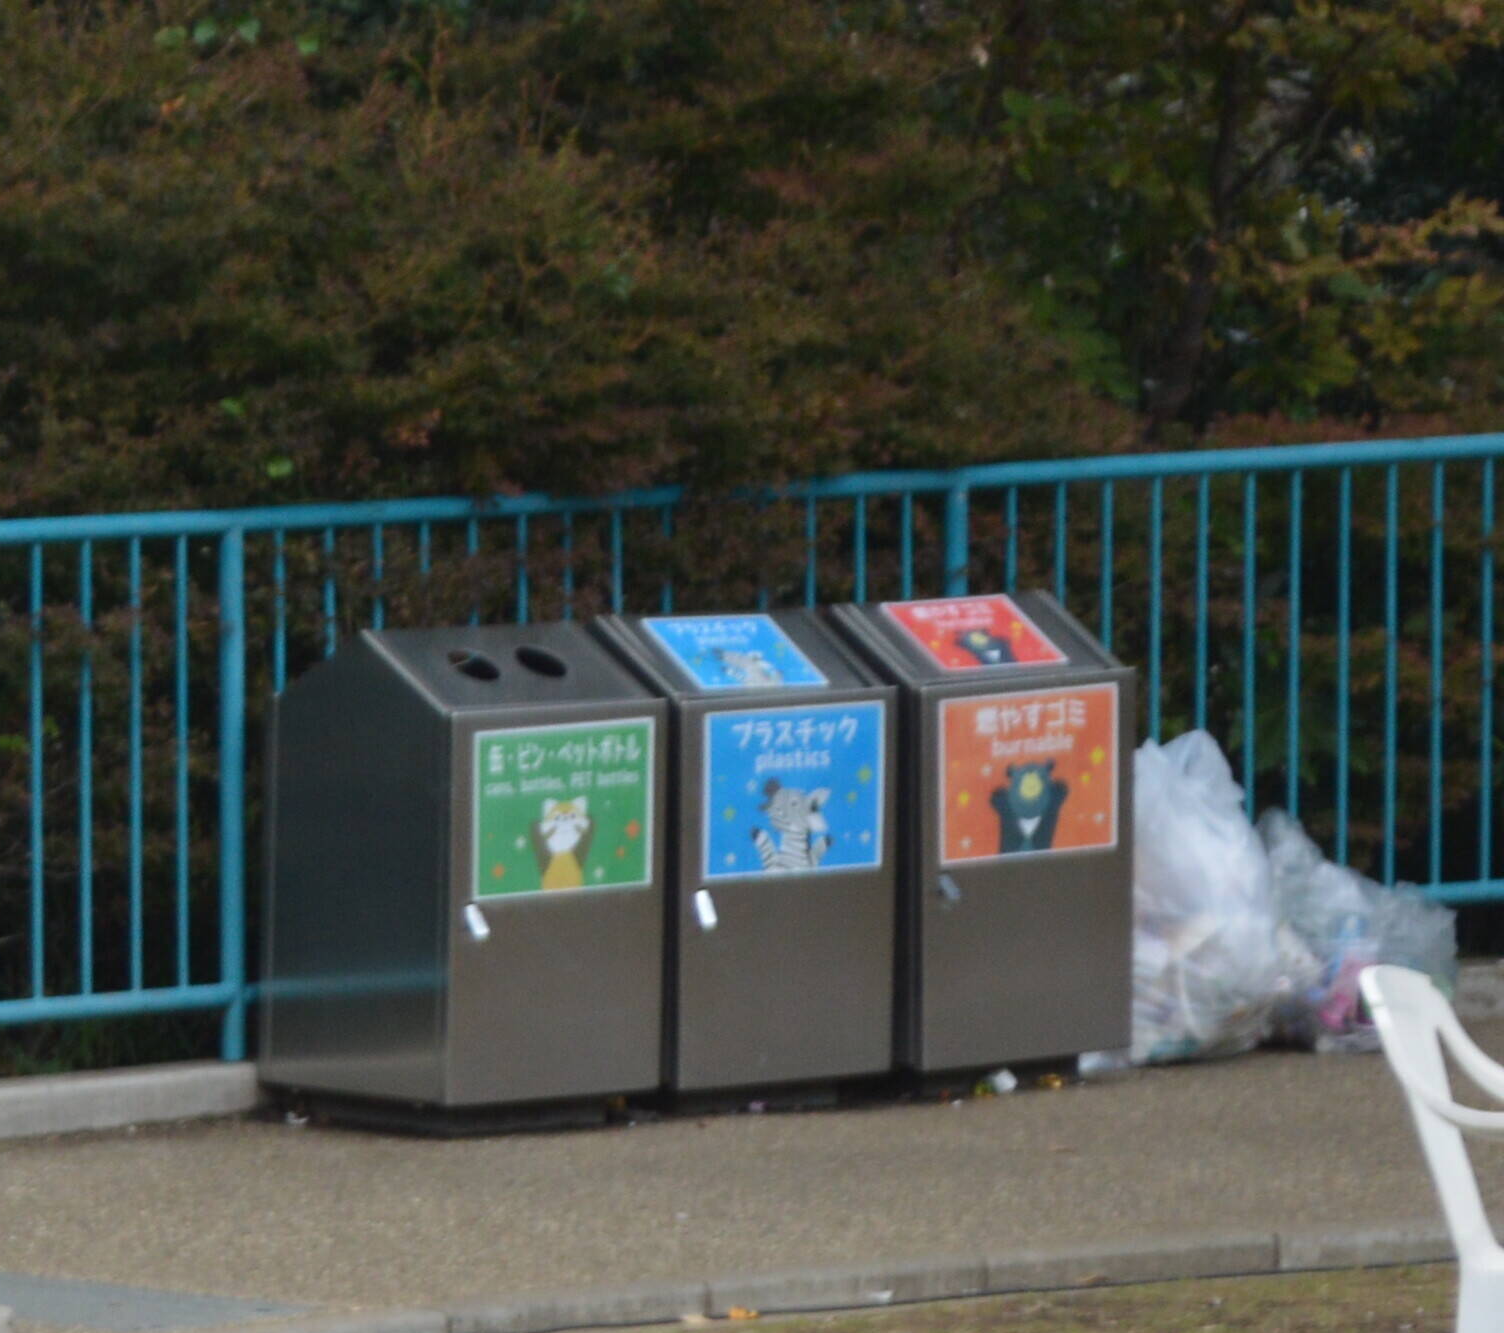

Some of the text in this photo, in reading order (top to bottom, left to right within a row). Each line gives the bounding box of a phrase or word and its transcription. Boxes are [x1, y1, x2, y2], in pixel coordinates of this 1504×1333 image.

[732, 715, 858, 748] プラスチック
[755, 749, 832, 773] plastics
